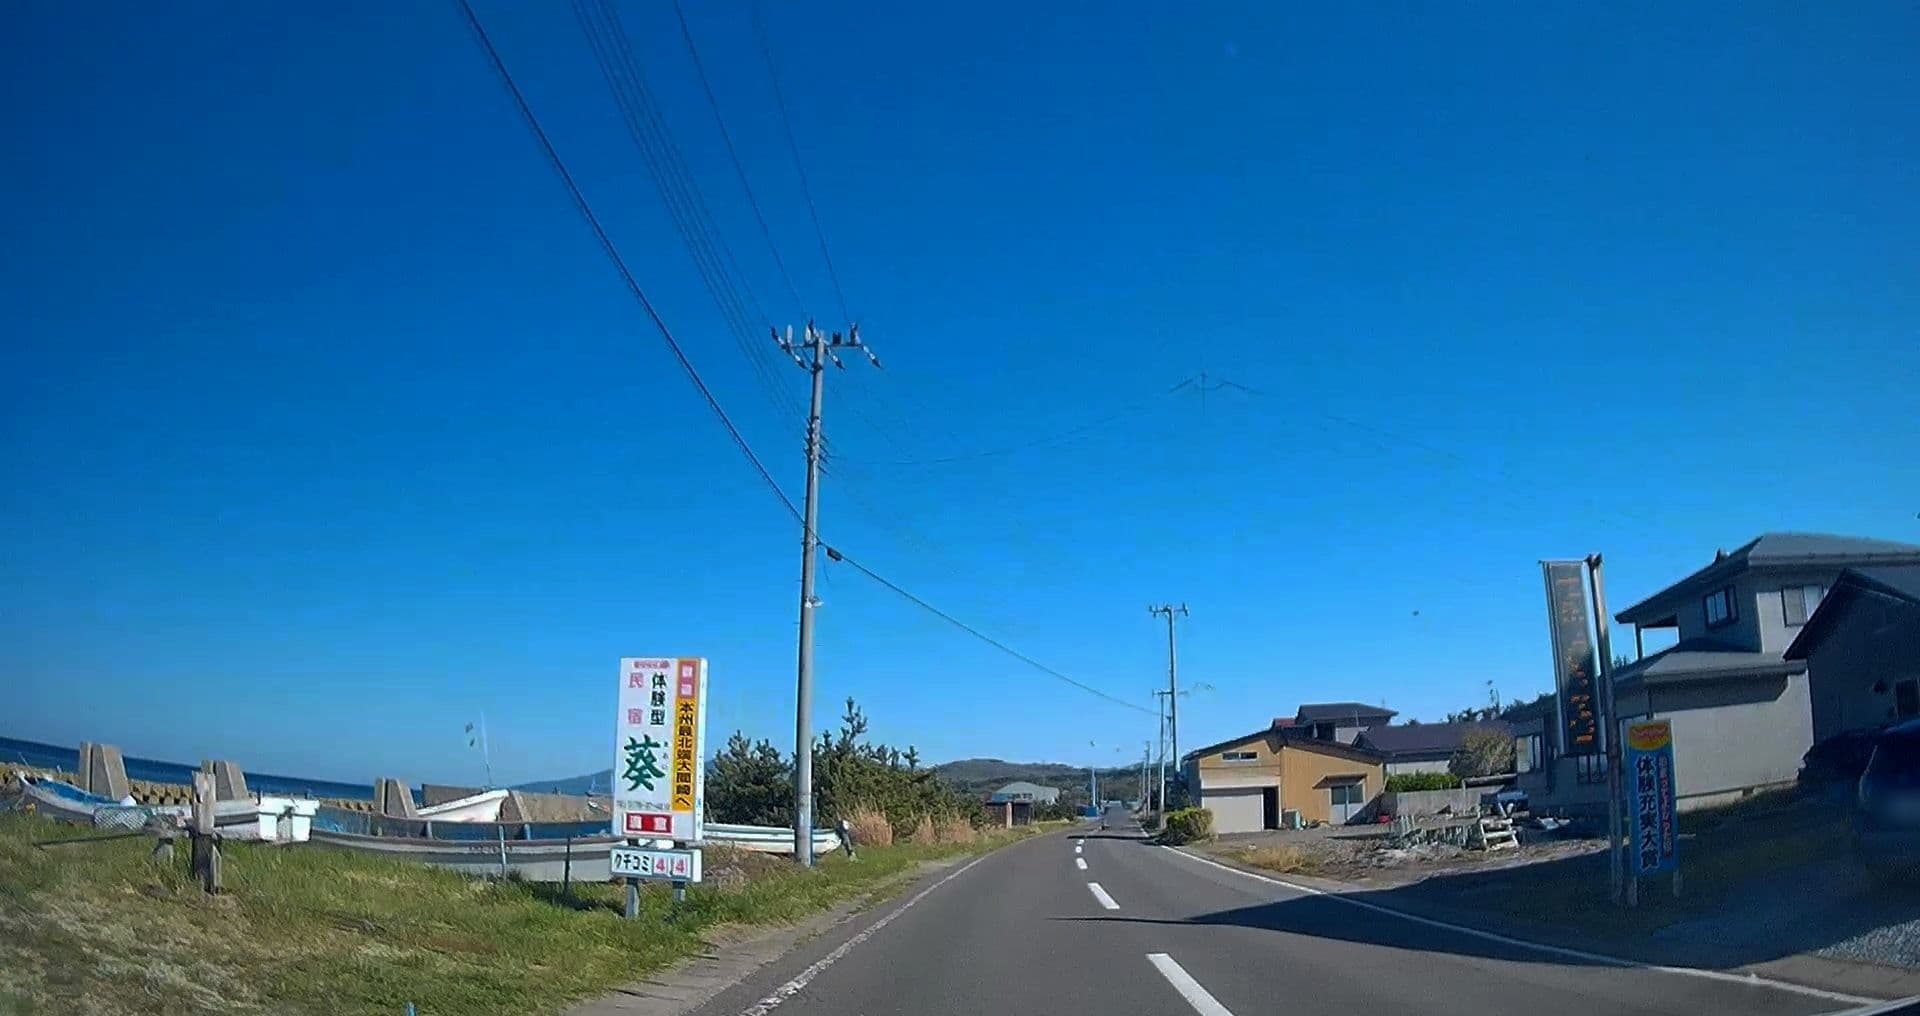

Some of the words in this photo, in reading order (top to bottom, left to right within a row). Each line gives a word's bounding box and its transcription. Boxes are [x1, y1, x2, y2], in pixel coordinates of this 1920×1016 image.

[627, 672, 645, 724] 民宿
[650, 671, 668, 726] 体験型
[621, 733, 666, 792] 葵
[614, 852, 650, 872] クチコミ
